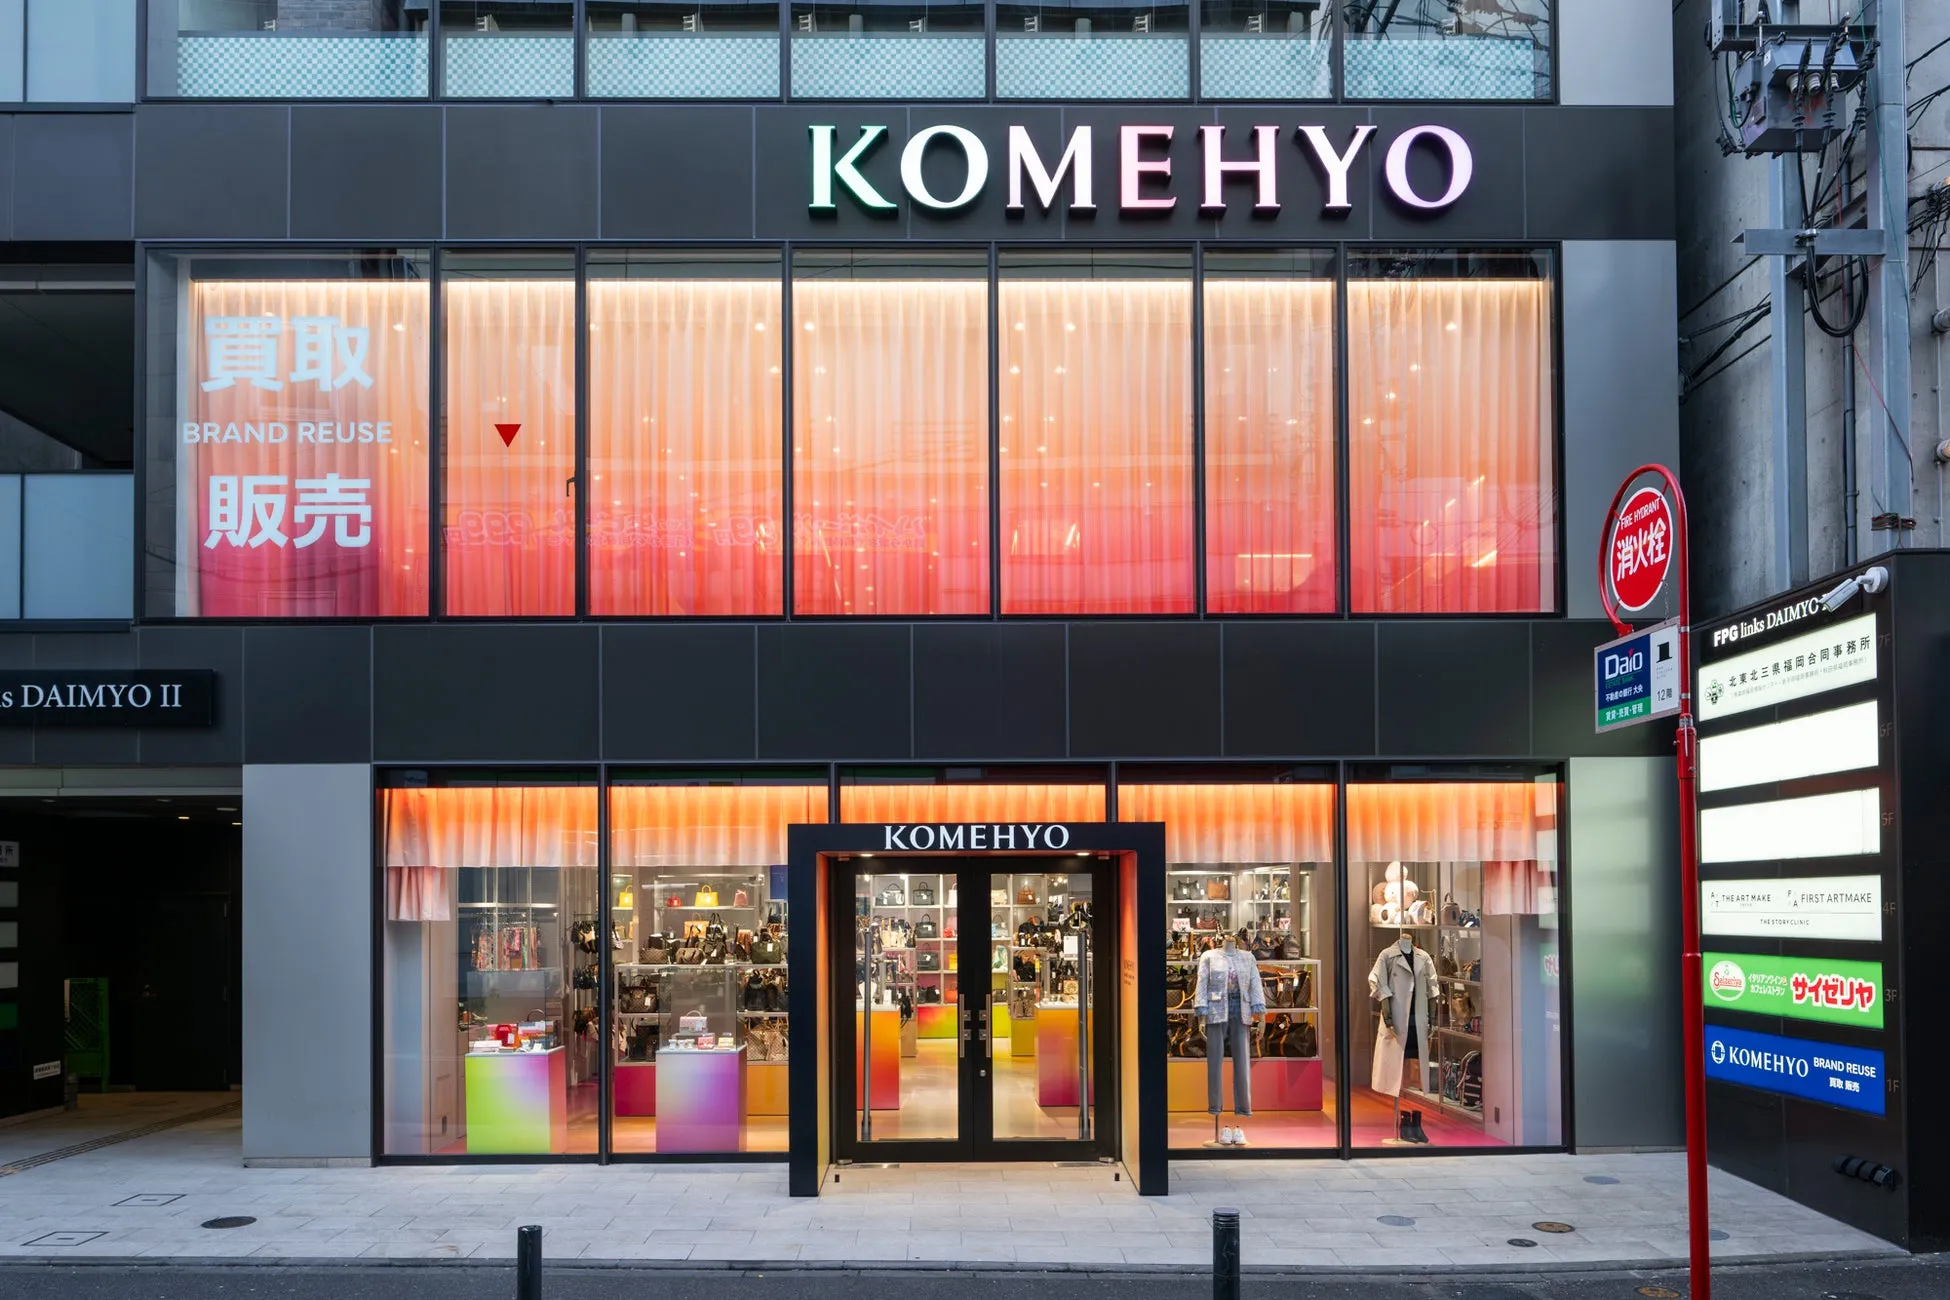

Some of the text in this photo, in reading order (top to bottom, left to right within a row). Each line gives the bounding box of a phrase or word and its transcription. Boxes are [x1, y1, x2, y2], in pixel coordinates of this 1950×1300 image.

[806, 123, 1474, 212] KOMEHYO
[201, 316, 375, 393] 買取
[182, 421, 393, 444] BRAND REUSE
[203, 472, 372, 549] 販売
[1620, 498, 1660, 530] FIRE HYDRANT
[1616, 517, 1667, 582] 消火栓
[1713, 624, 1739, 647] FPG
[1740, 617, 1765, 639] links
[1604, 648, 1643, 681] Daio
[0, 684, 182, 708] s DAIMYO II
[884, 824, 1070, 850] KOMEHYO
[1750, 894, 1771, 902] MAKE
[1801, 893, 1825, 904] FIRST
[1883, 901, 1896, 916] 4F
[1791, 974, 1875, 1012] サイゼリヤ
[1885, 988, 1897, 1003] 3F
[1729, 1046, 1809, 1077] KOMEHYO
[1813, 1056, 1877, 1078] BRAND REUSE
[1887, 1078, 1900, 1094] 1F
